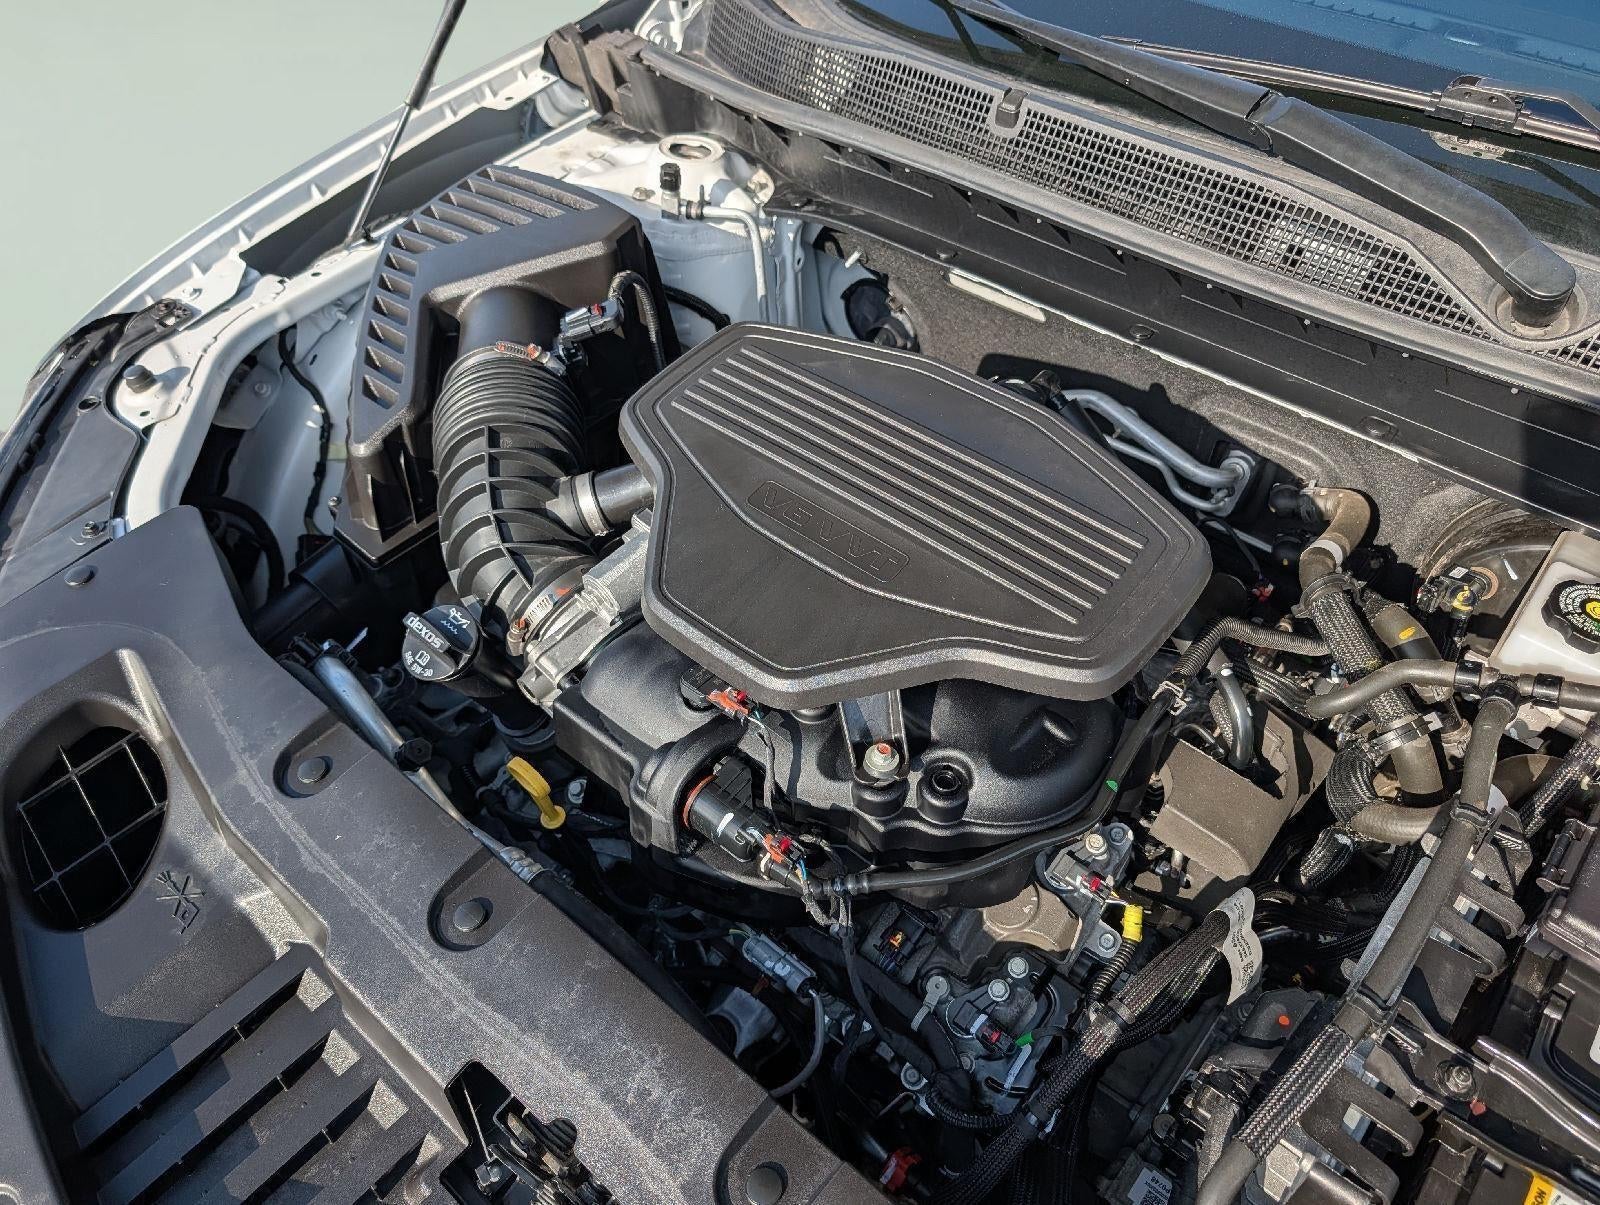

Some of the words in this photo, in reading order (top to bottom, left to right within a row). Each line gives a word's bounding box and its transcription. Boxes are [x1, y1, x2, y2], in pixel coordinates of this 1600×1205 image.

[764, 486, 813, 527] V6
[819, 518, 899, 571] VVT
[407, 616, 445, 649] dexos
[411, 664, 434, 677] 5W-30
